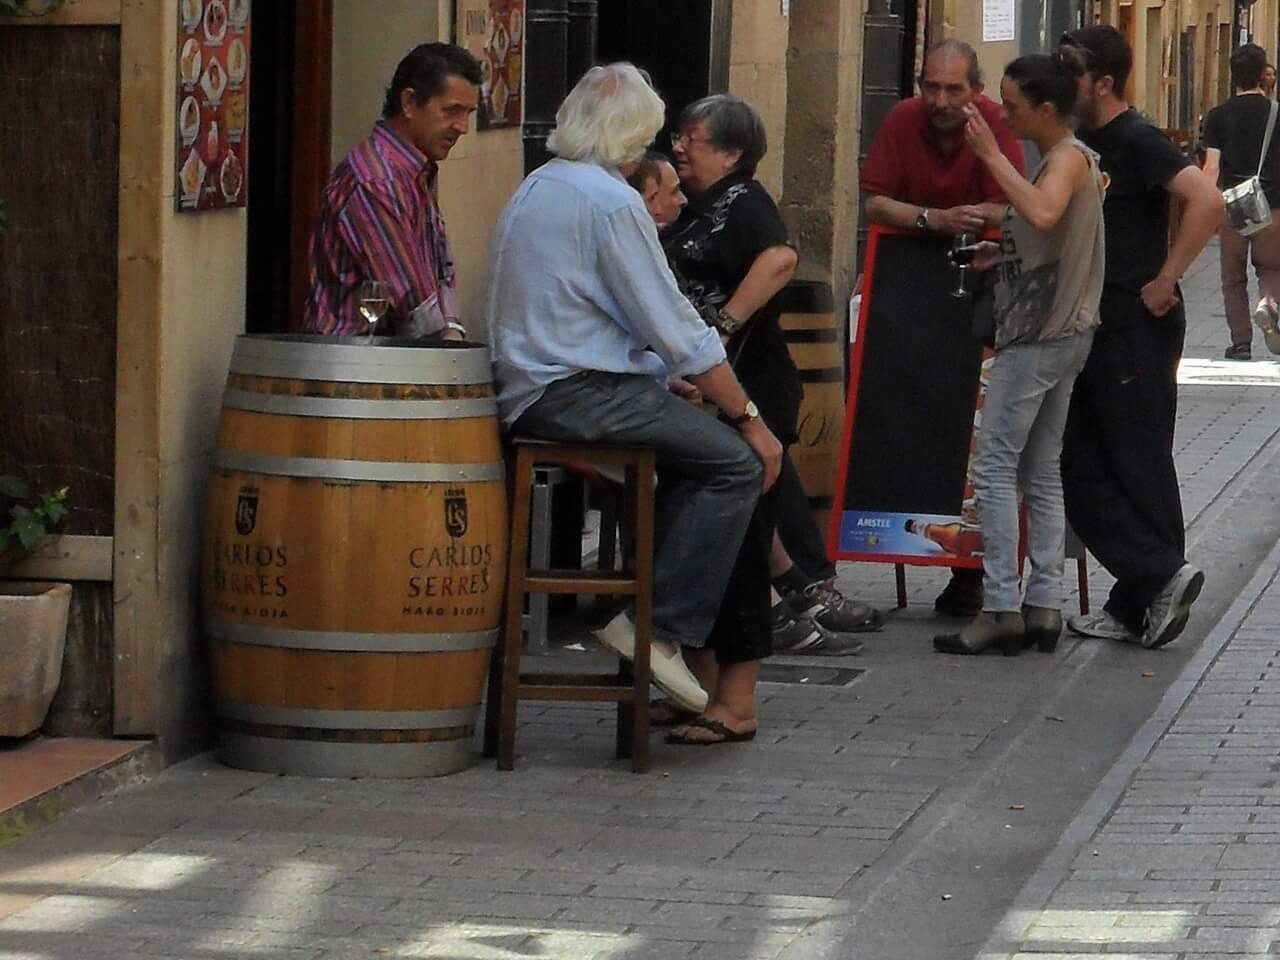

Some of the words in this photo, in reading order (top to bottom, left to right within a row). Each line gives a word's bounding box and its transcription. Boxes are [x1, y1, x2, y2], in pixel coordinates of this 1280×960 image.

[857, 517, 891, 528] AMSTEL
[409, 544, 492, 568] CARLOS
[408, 572, 490, 598] SERRES
